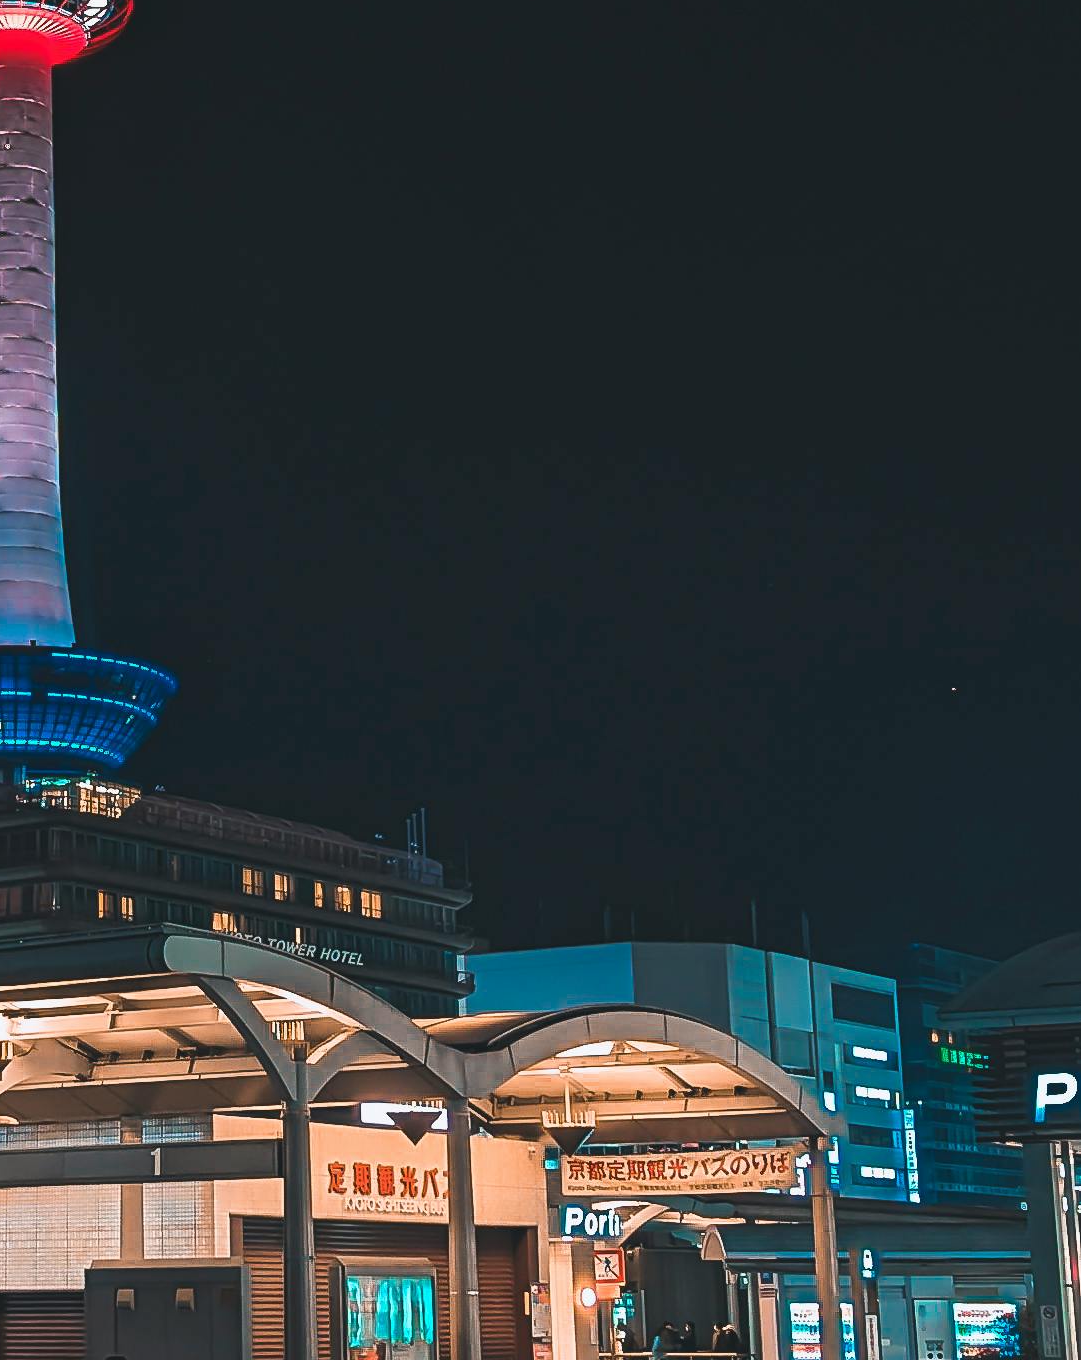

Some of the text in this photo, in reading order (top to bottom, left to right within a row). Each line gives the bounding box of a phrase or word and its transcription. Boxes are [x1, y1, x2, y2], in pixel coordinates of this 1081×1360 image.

[320, 947, 364, 966] HOTEL
[1035, 1072, 1078, 1122] P
[150, 1148, 161, 1175] 1
[567, 1151, 791, 1181] 京都定期観光バスのりば
